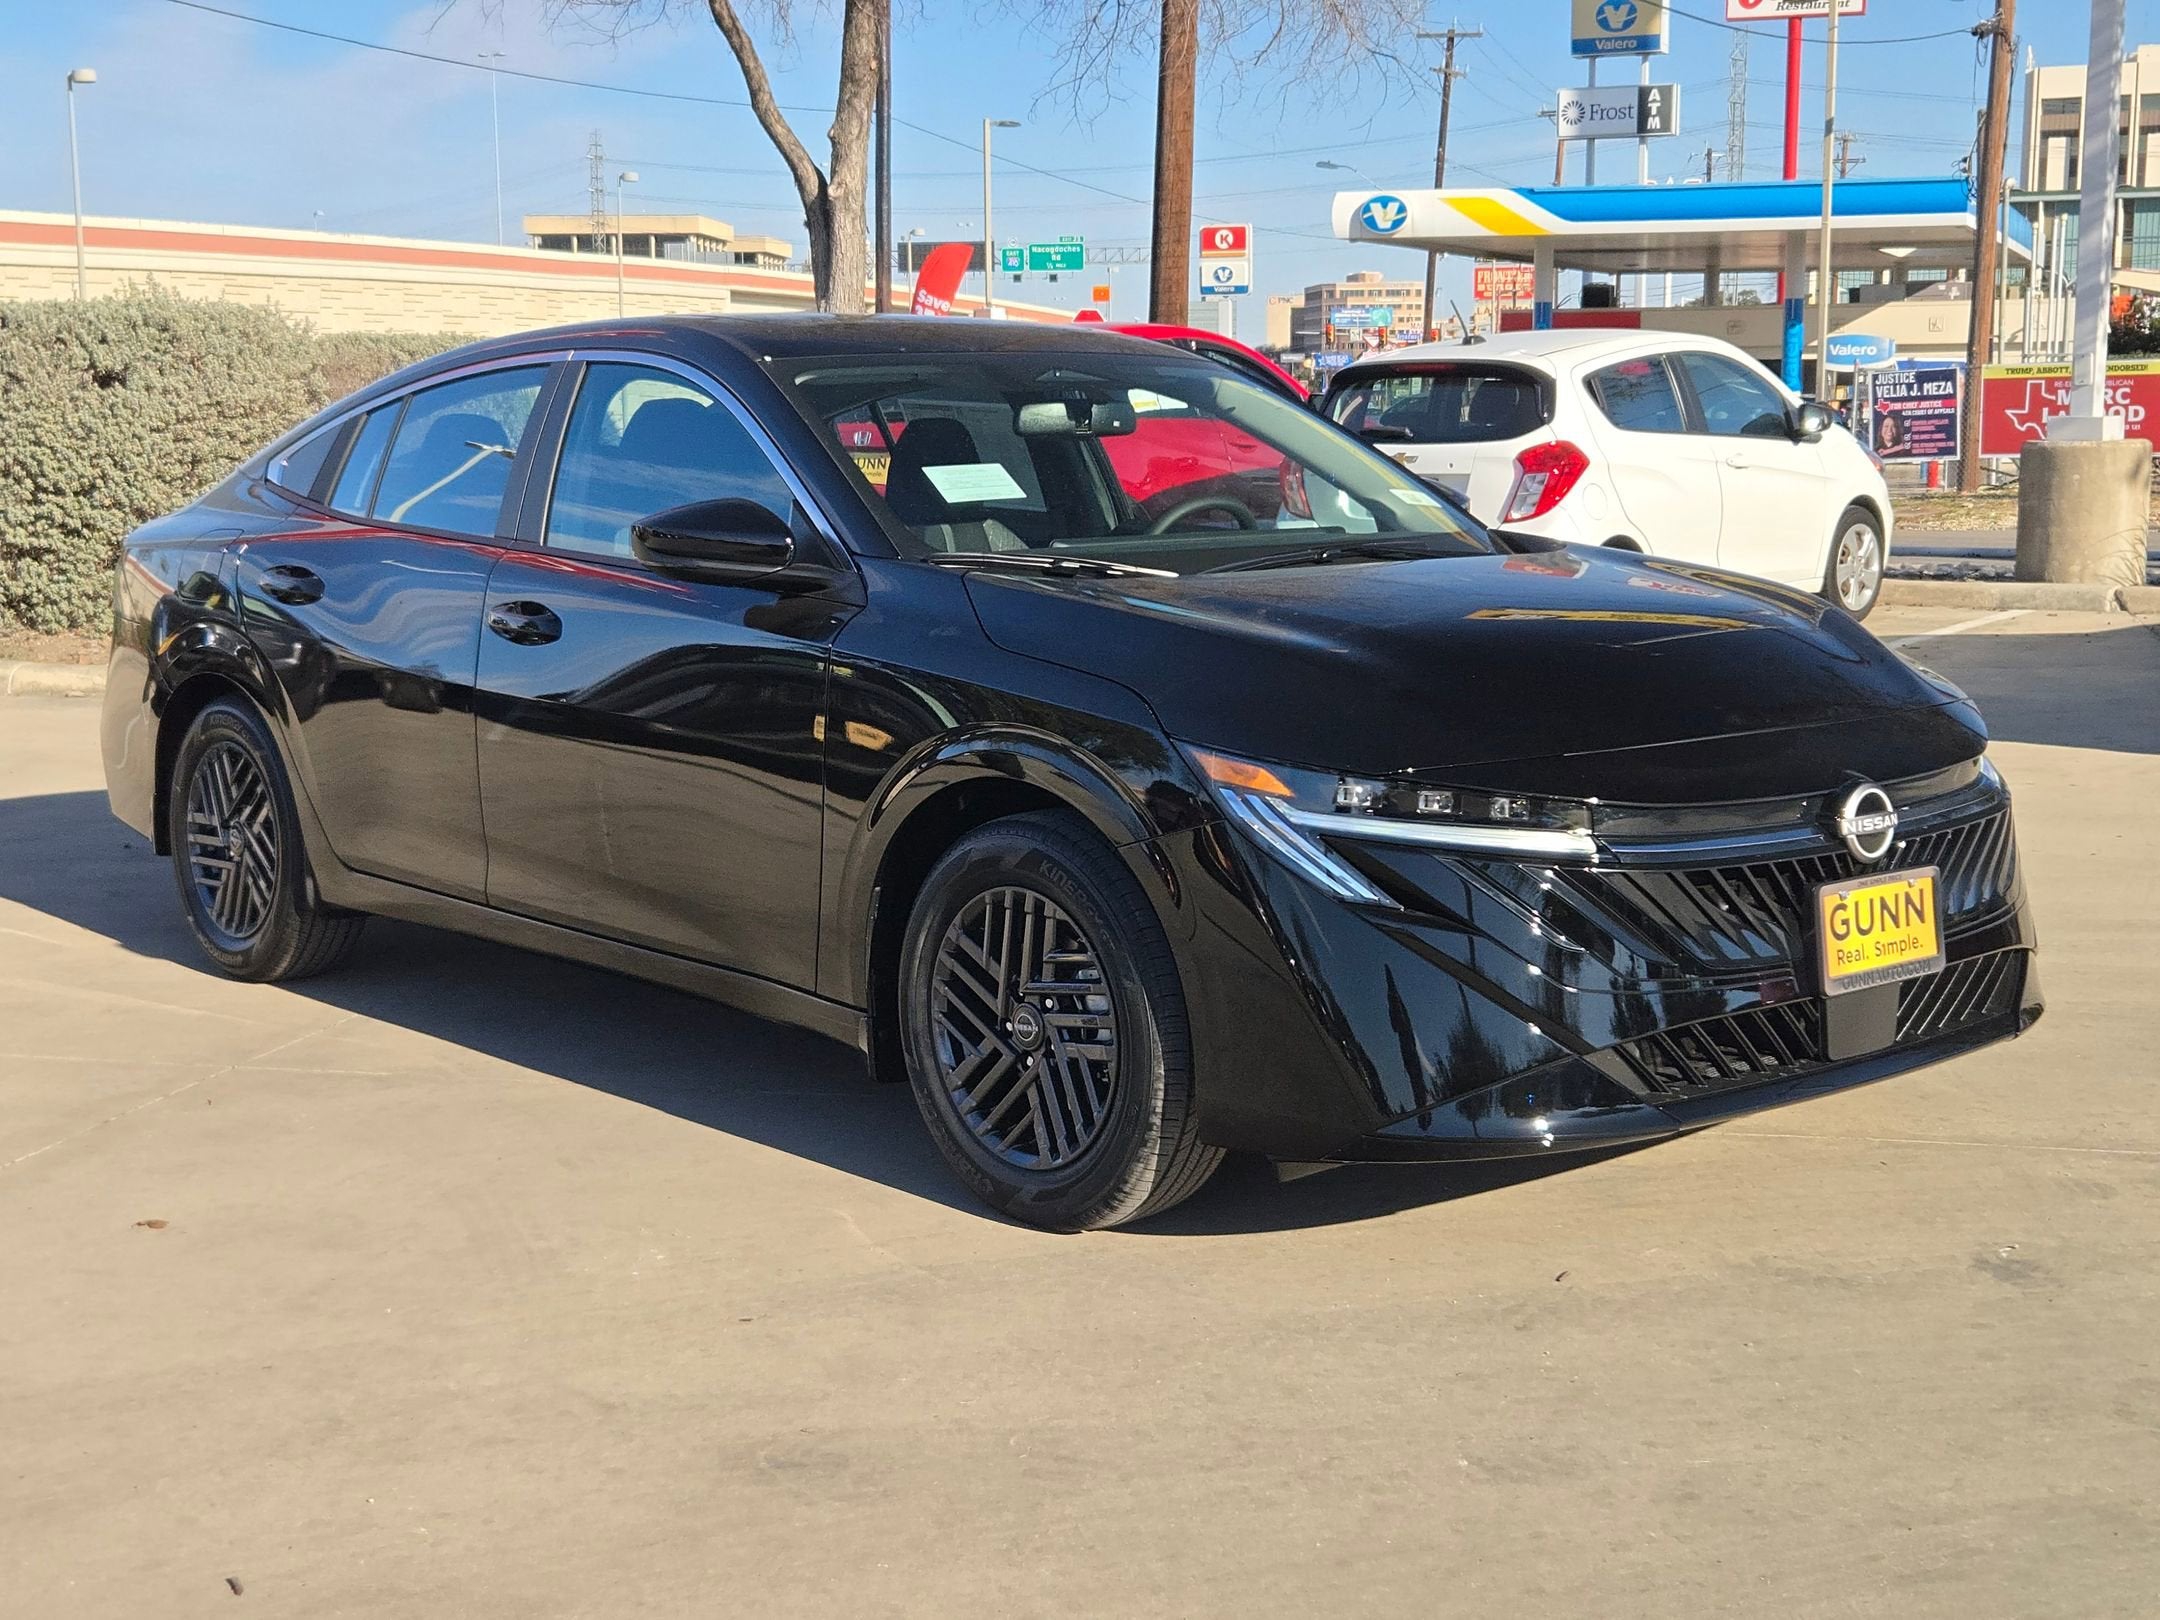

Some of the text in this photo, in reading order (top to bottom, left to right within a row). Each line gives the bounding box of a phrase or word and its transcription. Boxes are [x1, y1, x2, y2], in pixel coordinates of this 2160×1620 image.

[1775, 0, 1849, 11] Restaurnt
[1595, 39, 1637, 50] Valero
[1589, 103, 1635, 121] Frost
[1647, 88, 1661, 130] ATM
[1031, 246, 1081, 254] Nacogdoches
[917, 288, 951, 312] Save
[1829, 344, 1877, 356] Valero
[2005, 367, 2034, 375] TRUMP,
[2106, 363, 2149, 372] NDORSED!
[1875, 372, 1916, 385] JUSTICE
[1875, 381, 1954, 398] VELIA J. MEZA
[2057, 387, 2131, 405] MRC
[857, 457, 887, 469] UNN
[1845, 813, 1898, 835] NISSAN
[1829, 888, 1925, 941] GUNN
[1836, 934, 1924, 966] Real. Simple.
